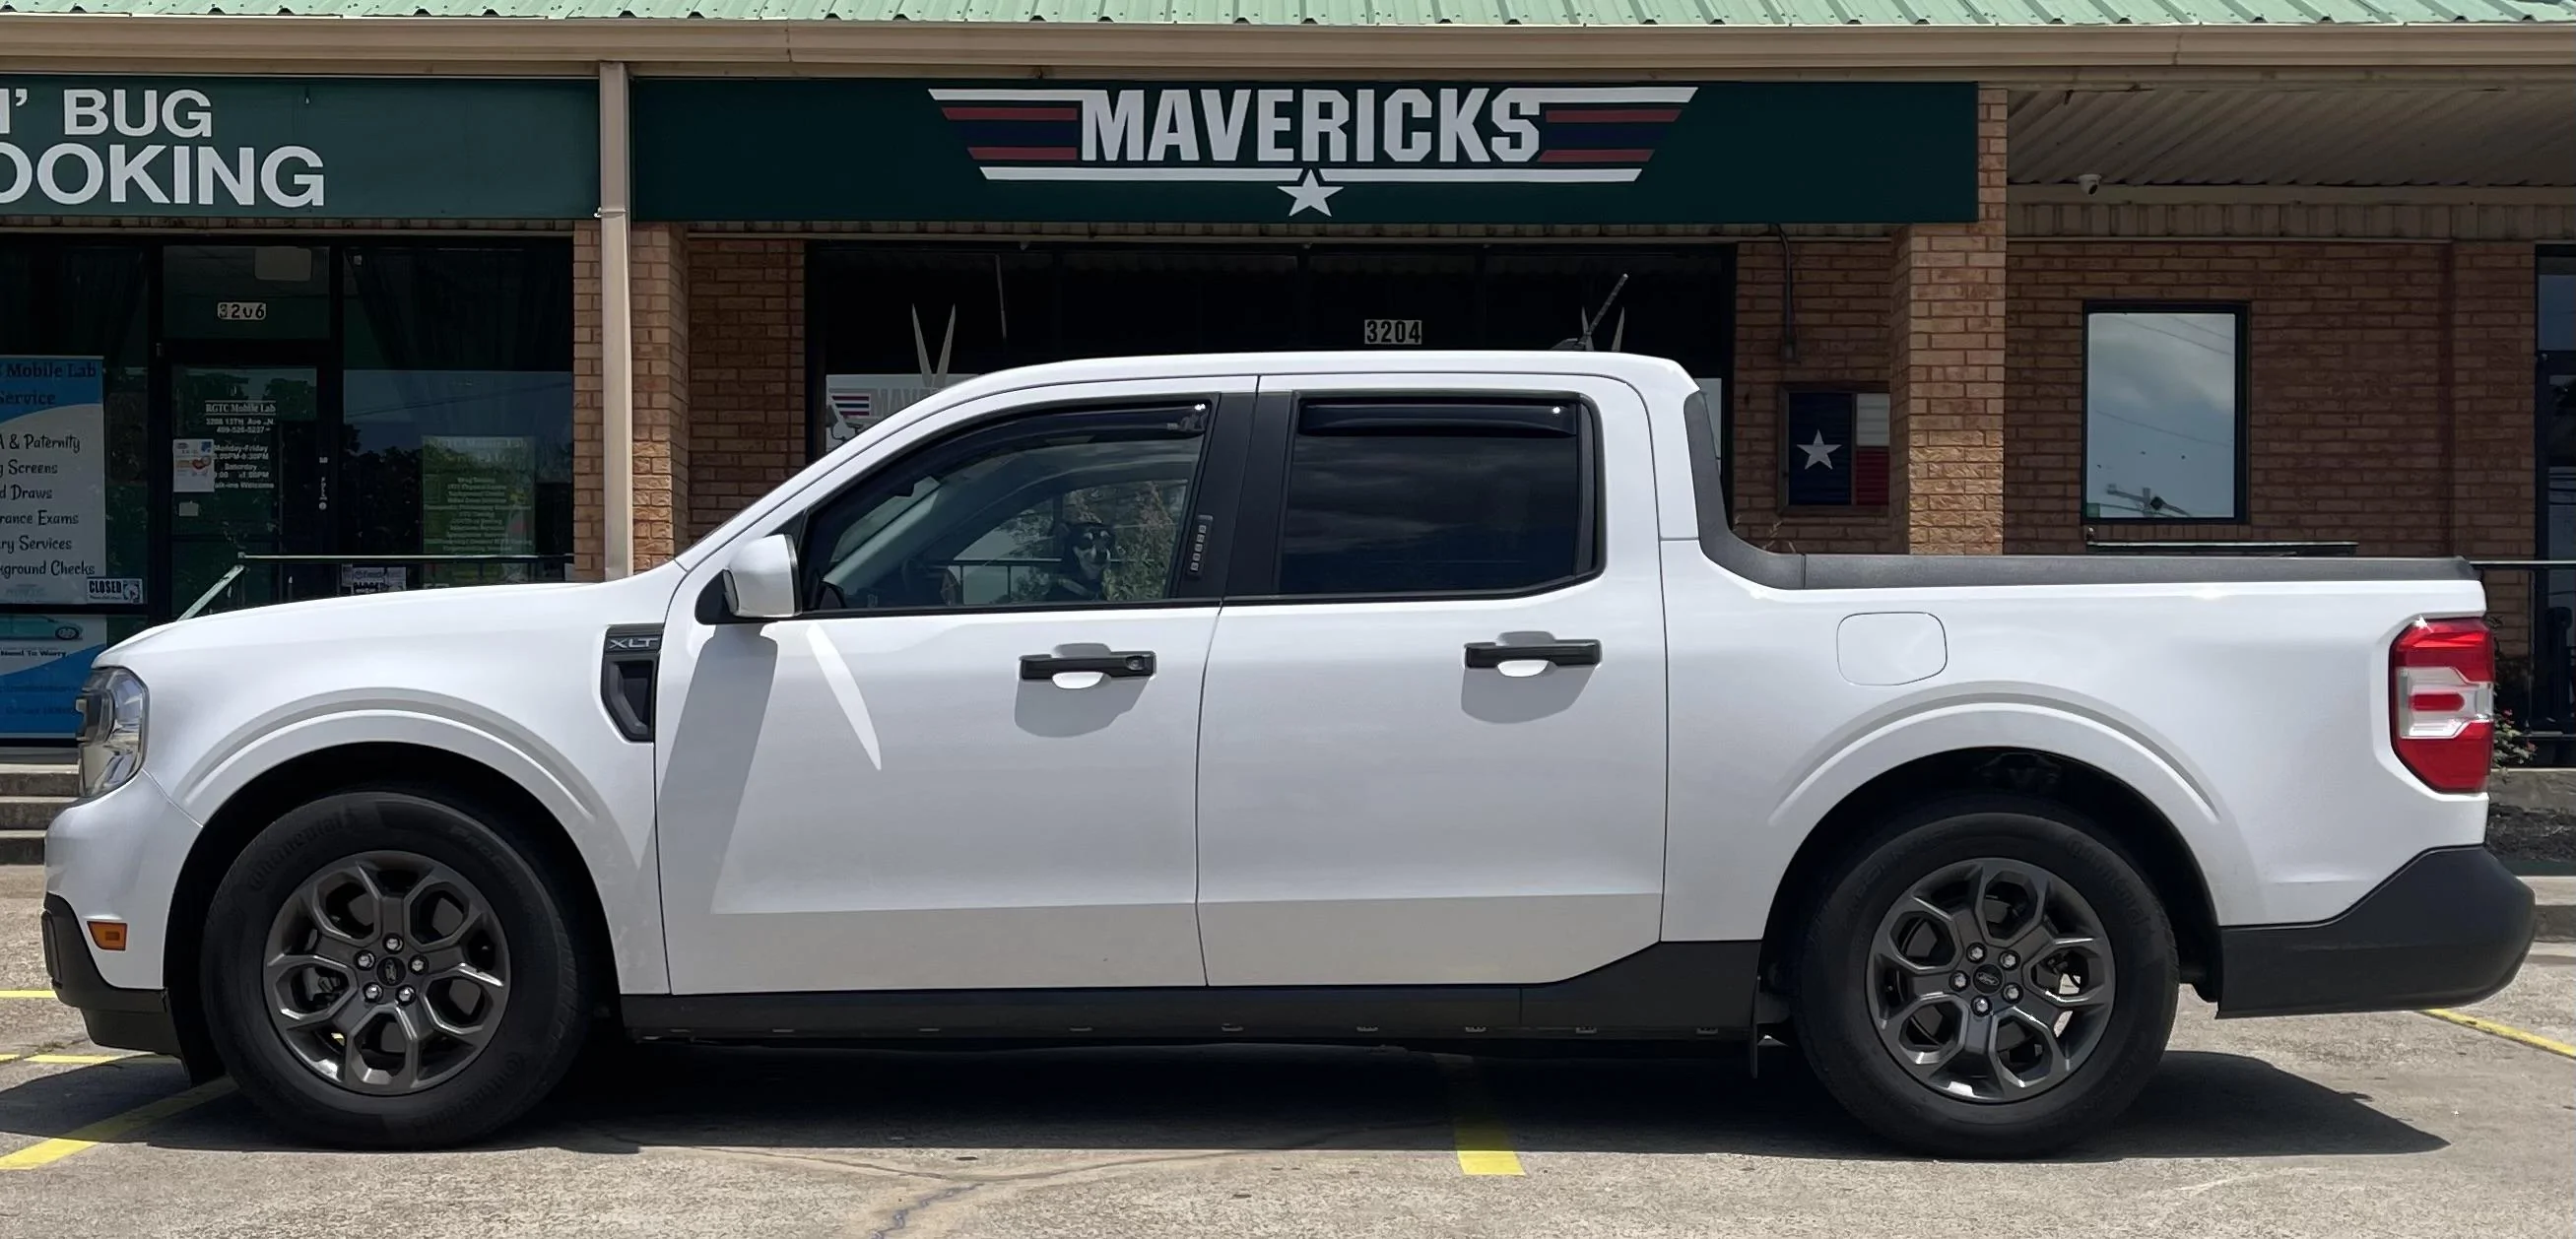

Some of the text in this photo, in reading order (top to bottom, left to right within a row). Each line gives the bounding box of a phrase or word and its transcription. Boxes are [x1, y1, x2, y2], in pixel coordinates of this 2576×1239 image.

[64, 89, 212, 138] BUG
[1082, 88, 1541, 163] MAVERICKS
[1366, 320, 1420, 344] 3204
[7, 362, 62, 378] Mobile
[67, 362, 97, 378] Lab
[260, 403, 276, 413] Lab
[9, 434, 20, 449] &
[24, 434, 81, 453] Paternity
[8, 459, 58, 476] Screens
[10, 484, 53, 500] Draws
[37, 509, 80, 526] Exams
[19, 535, 73, 551] Services
[50, 559, 96, 576] Checks
[89, 580, 122, 593] CLOSED
[609, 638, 659, 649] XLT
